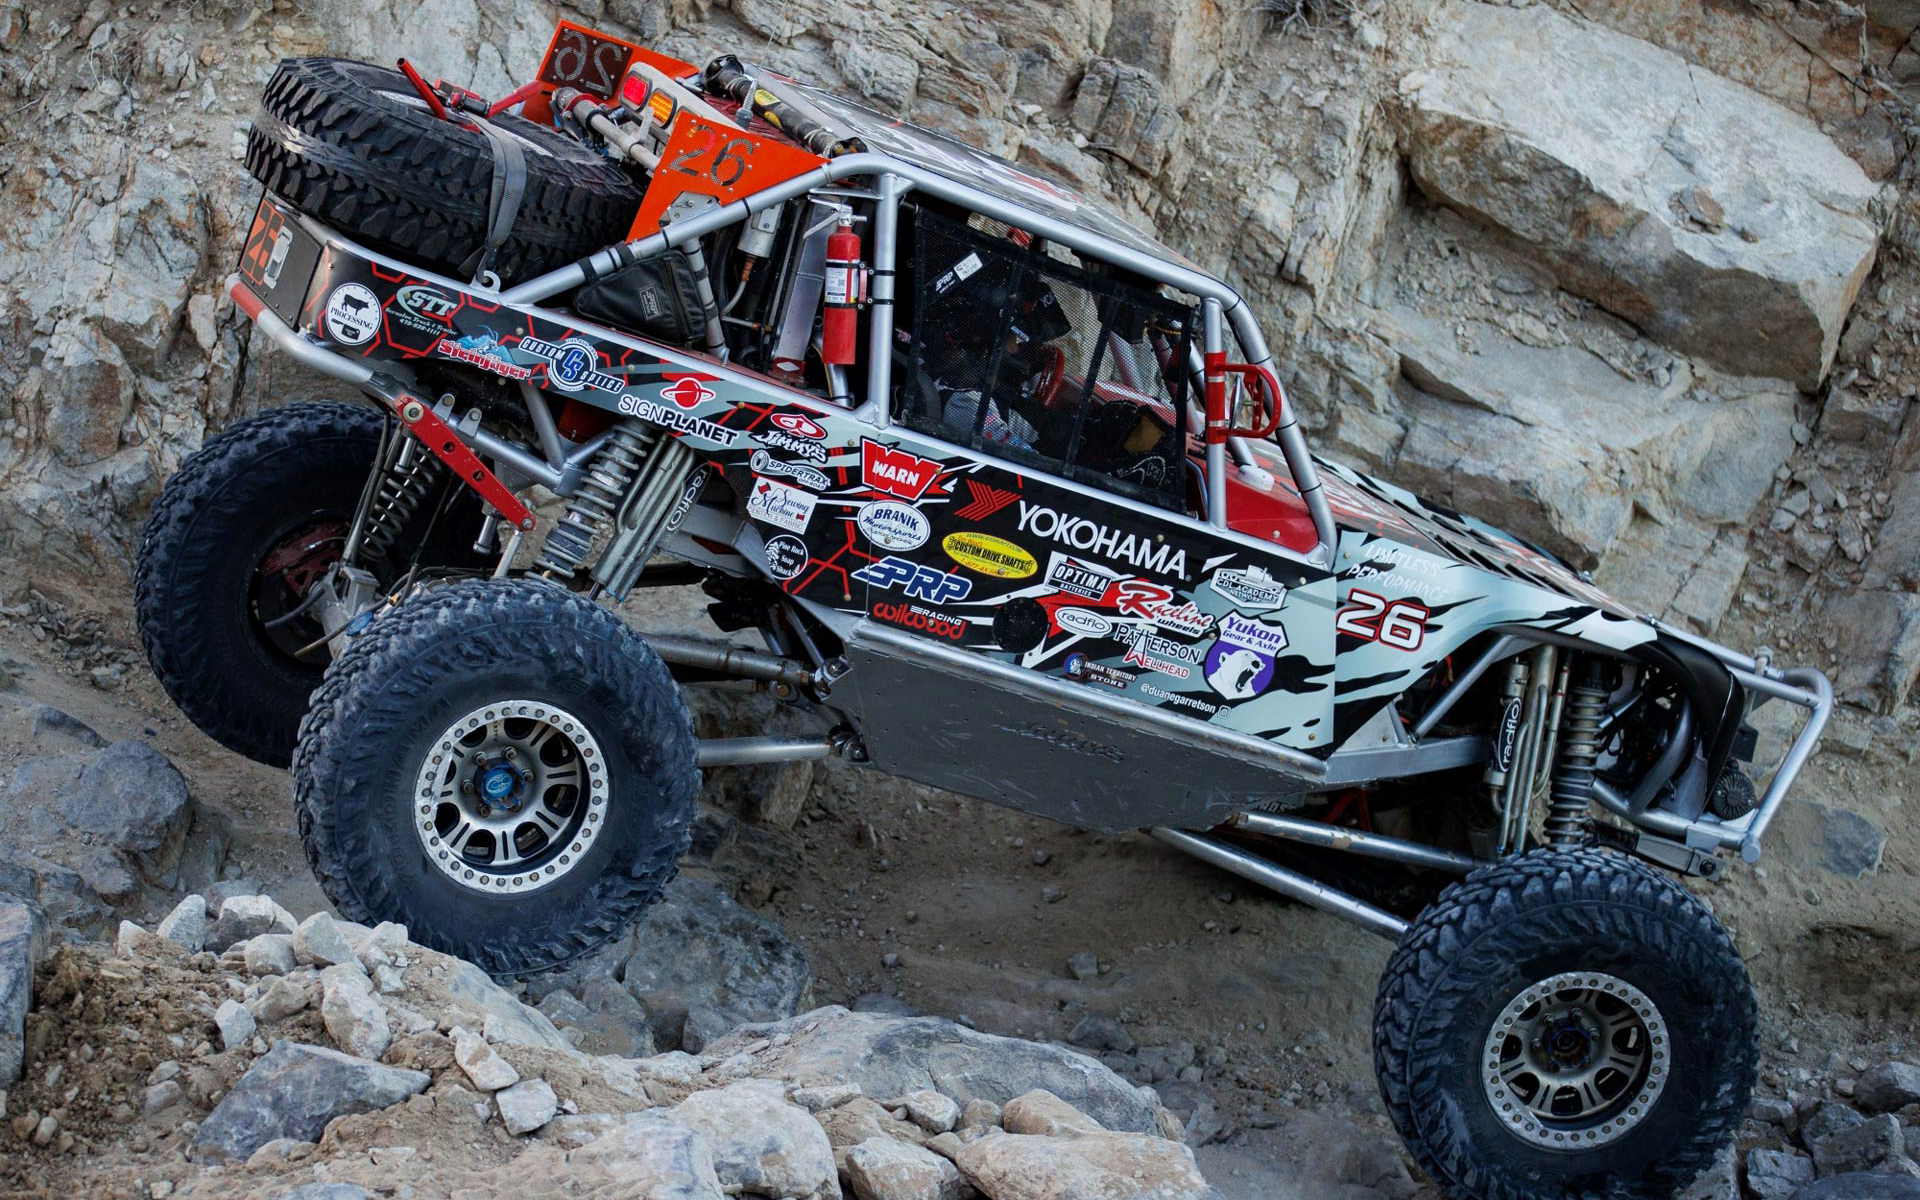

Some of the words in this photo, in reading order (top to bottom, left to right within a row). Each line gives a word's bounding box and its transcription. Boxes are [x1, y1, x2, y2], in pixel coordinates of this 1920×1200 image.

[669, 125, 753, 187] 26
[407, 291, 457, 316] STT
[330, 306, 373, 330] PROCESSING
[413, 315, 434, 327] Truck
[522, 338, 566, 360] CUSTOM
[580, 371, 622, 391] SPLICE
[562, 349, 585, 381] CS
[619, 395, 738, 446] SIGNPLANET
[768, 458, 829, 487] SPIDERTRAX
[872, 460, 920, 487] WARN
[671, 469, 708, 525] radflo
[751, 493, 794, 518] Machine
[780, 489, 809, 514] Sewing
[863, 516, 921, 541] Motorsports
[873, 509, 919, 531] BRANIK
[779, 541, 791, 551] Pine
[791, 545, 804, 556] Rock
[1018, 500, 1186, 580] YOKOHAMA
[781, 554, 795, 566] Soap
[955, 541, 981, 557] CUSTOM
[981, 549, 1001, 563] DRIVE
[1000, 554, 1025, 572] SHAFTS
[1364, 544, 1441, 576] LIMITLESS
[852, 556, 972, 604] PRP
[1054, 564, 1107, 591] OPTIMA
[1060, 583, 1092, 596] BATTERIES
[1216, 578, 1235, 589] CDL
[1236, 585, 1280, 602] ACADEMY
[1345, 563, 1449, 600] PERFORMANCE
[1118, 580, 1214, 629] Raceline
[1230, 589, 1262, 602] NETWORK
[873, 601, 967, 640] wilwood
[921, 608, 963, 627] RACING
[1060, 612, 1106, 630] radflo
[1157, 618, 1201, 636] wheels
[1227, 616, 1281, 644] Yukon
[1336, 588, 1431, 652] 26
[1114, 624, 1200, 664] PATTERSON
[1223, 629, 1246, 642] Gear
[1246, 637, 1254, 645] &
[1255, 641, 1277, 652] Axle
[1085, 661, 1105, 674] INDIAN
[1106, 667, 1137, 682] TERRITORY
[1124, 649, 1191, 679] WELLHEAD
[1089, 674, 1124, 688] STONE
[1140, 683, 1216, 714] @duanegarretson
[1502, 704, 1520, 764] radflo
